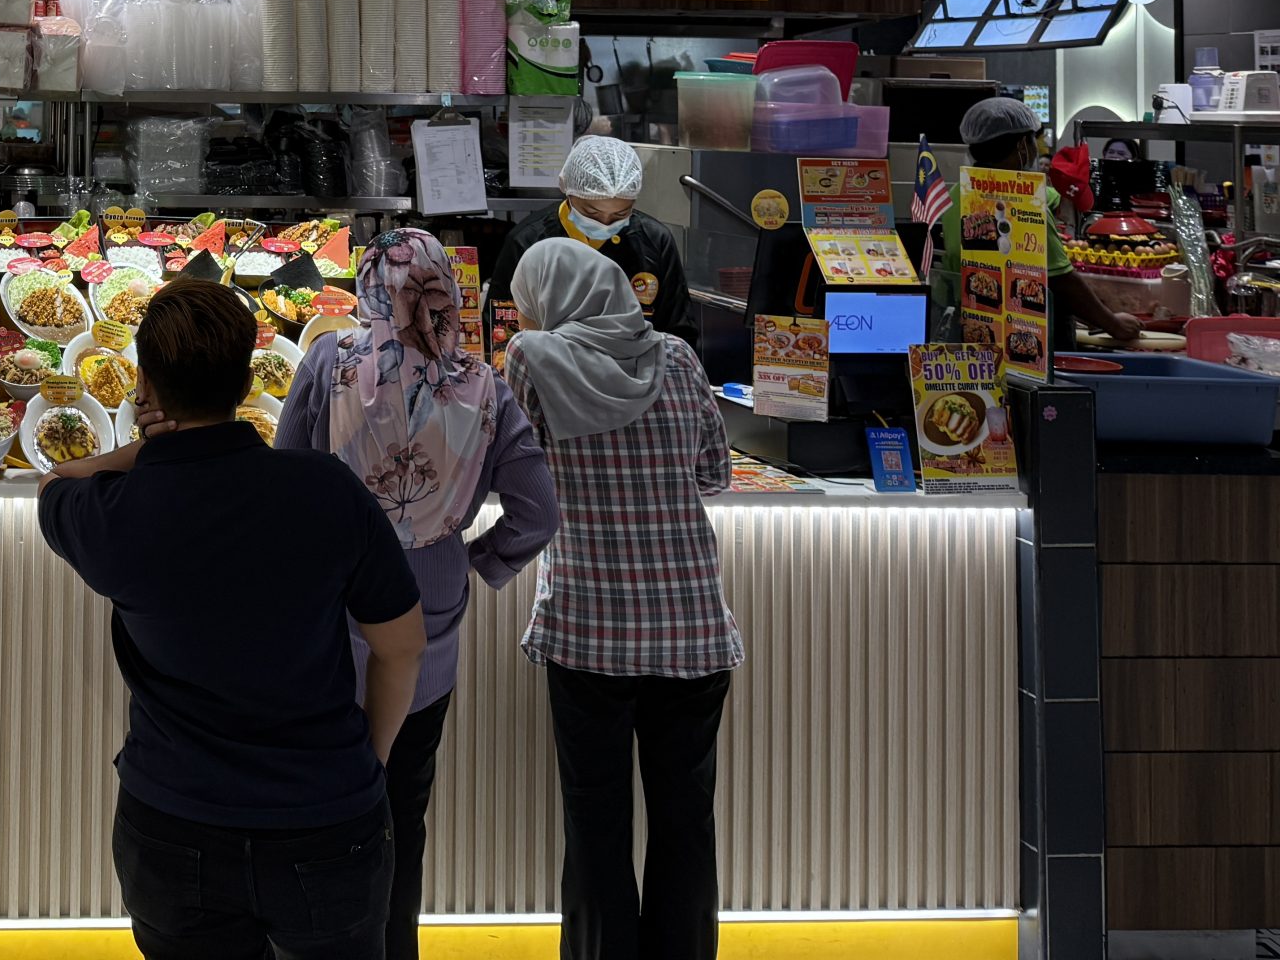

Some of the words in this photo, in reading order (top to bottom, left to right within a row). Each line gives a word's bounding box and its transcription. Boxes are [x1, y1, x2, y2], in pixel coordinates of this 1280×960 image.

[969, 176, 1035, 196] TeppanYaki
[921, 351, 938, 362] BUY
[954, 351, 970, 362] GET
[975, 350, 994, 362] 2ND
[923, 363, 961, 381] 50%
[967, 362, 995, 381] OFF
[924, 382, 956, 391] OMELETTE
[957, 382, 979, 391] CURRY
[981, 382, 995, 391] RICE
